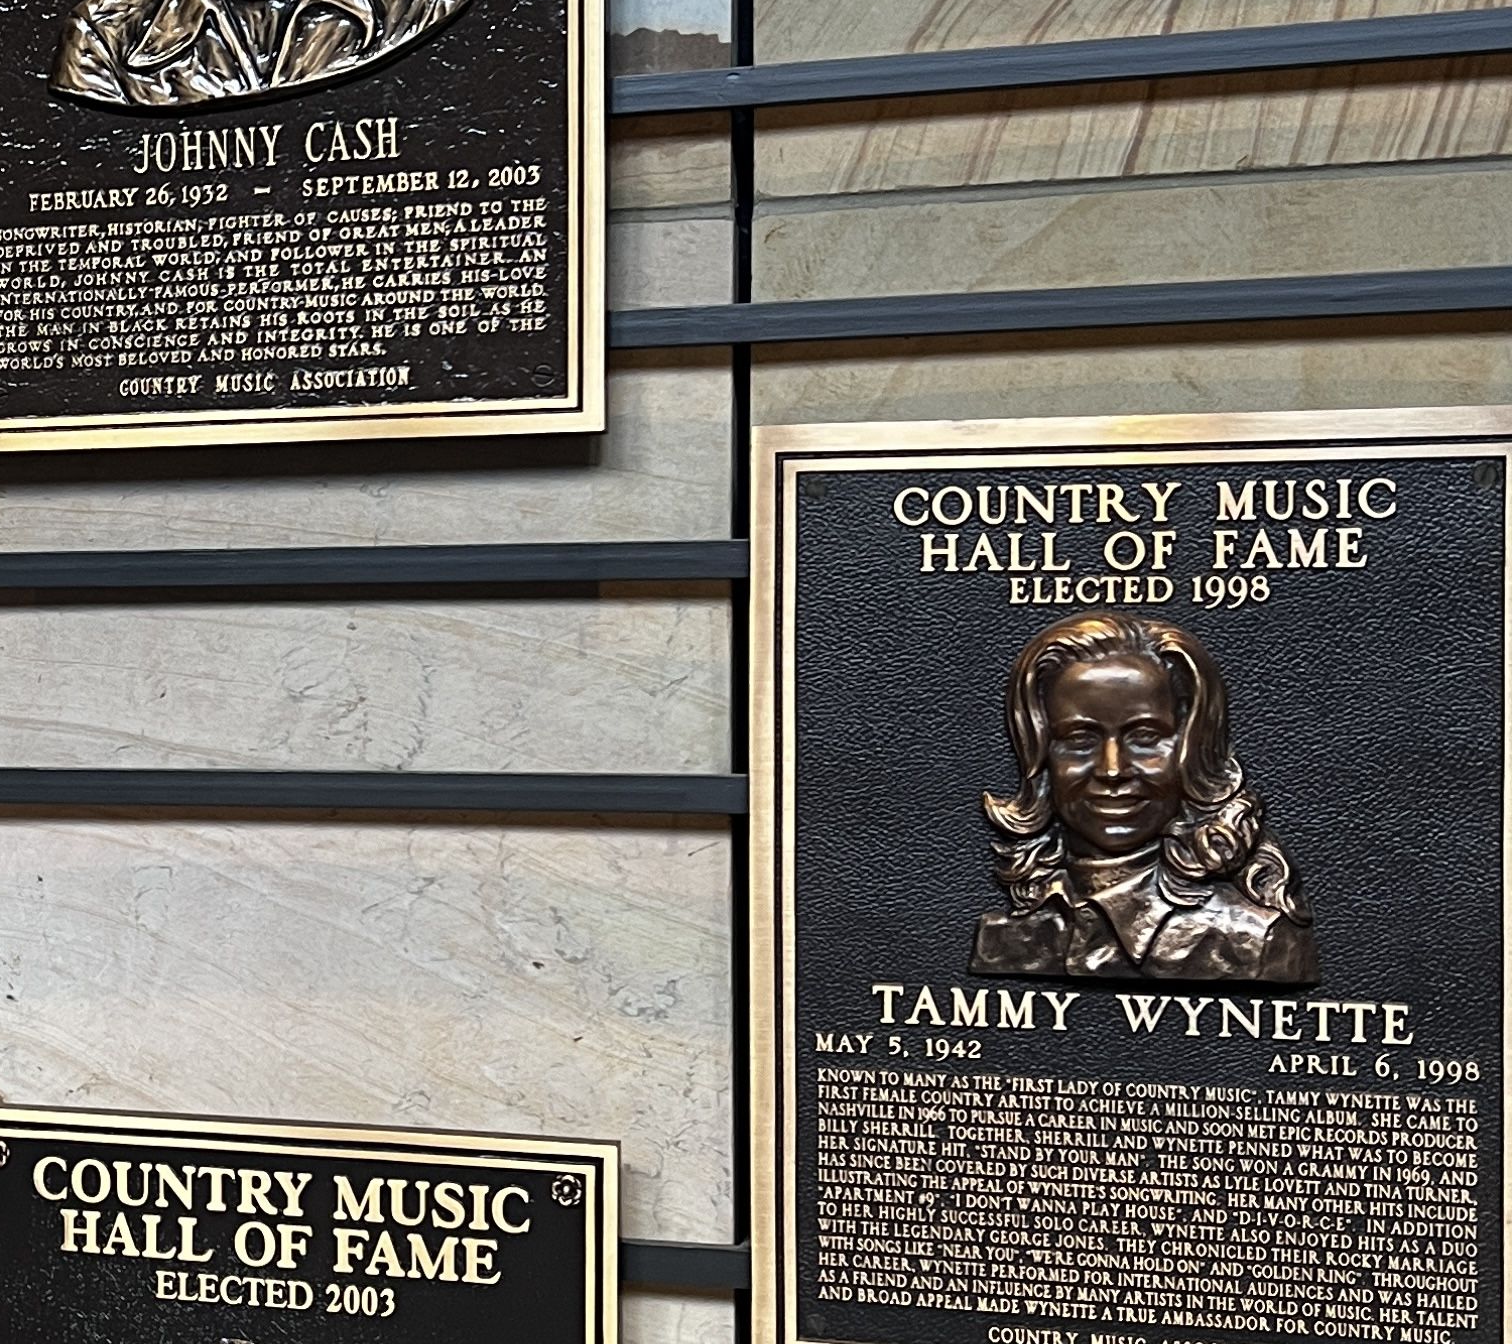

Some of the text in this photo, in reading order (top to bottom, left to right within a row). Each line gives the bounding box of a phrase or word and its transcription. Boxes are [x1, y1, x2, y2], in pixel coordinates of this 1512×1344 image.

[133, 116, 402, 175] JOHNNY CASH
[29, 187, 139, 212] FEBRUARY
[302, 170, 439, 197] SEPTEMBER
[447, 170, 481, 189] 12,
[488, 165, 541, 187] 2003
[71, 353, 111, 369] MOST
[118, 349, 191, 367] BELOVED
[197, 347, 237, 363] AND
[241, 343, 323, 362] HONORED
[329, 341, 387, 357] STARS.
[119, 366, 410, 398] COUNTRY MUSIC ASSOCIATION
[893, 478, 1398, 529] COUNTRY MUSIC
[919, 527, 1369, 573] HALL OF FAME
[1009, 575, 1271, 611] ELECTED 1998
[871, 984, 1415, 1047] TAMMY WYNETTE
[815, 1033, 982, 1062] MAY 5, 1942
[1268, 1053, 1481, 1084] APRIL 6, 1998
[32, 1156, 532, 1235] COUNTRY MUSIC
[59, 1208, 503, 1286] HALL OF FAME
[154, 1270, 397, 1318] ELECTED 2003
[817, 1286, 1456, 1344] AND BROAD APPEAL MADE WYNETTE A TRUE AMBASSADOR FOR COUNTRY MUSIC.
